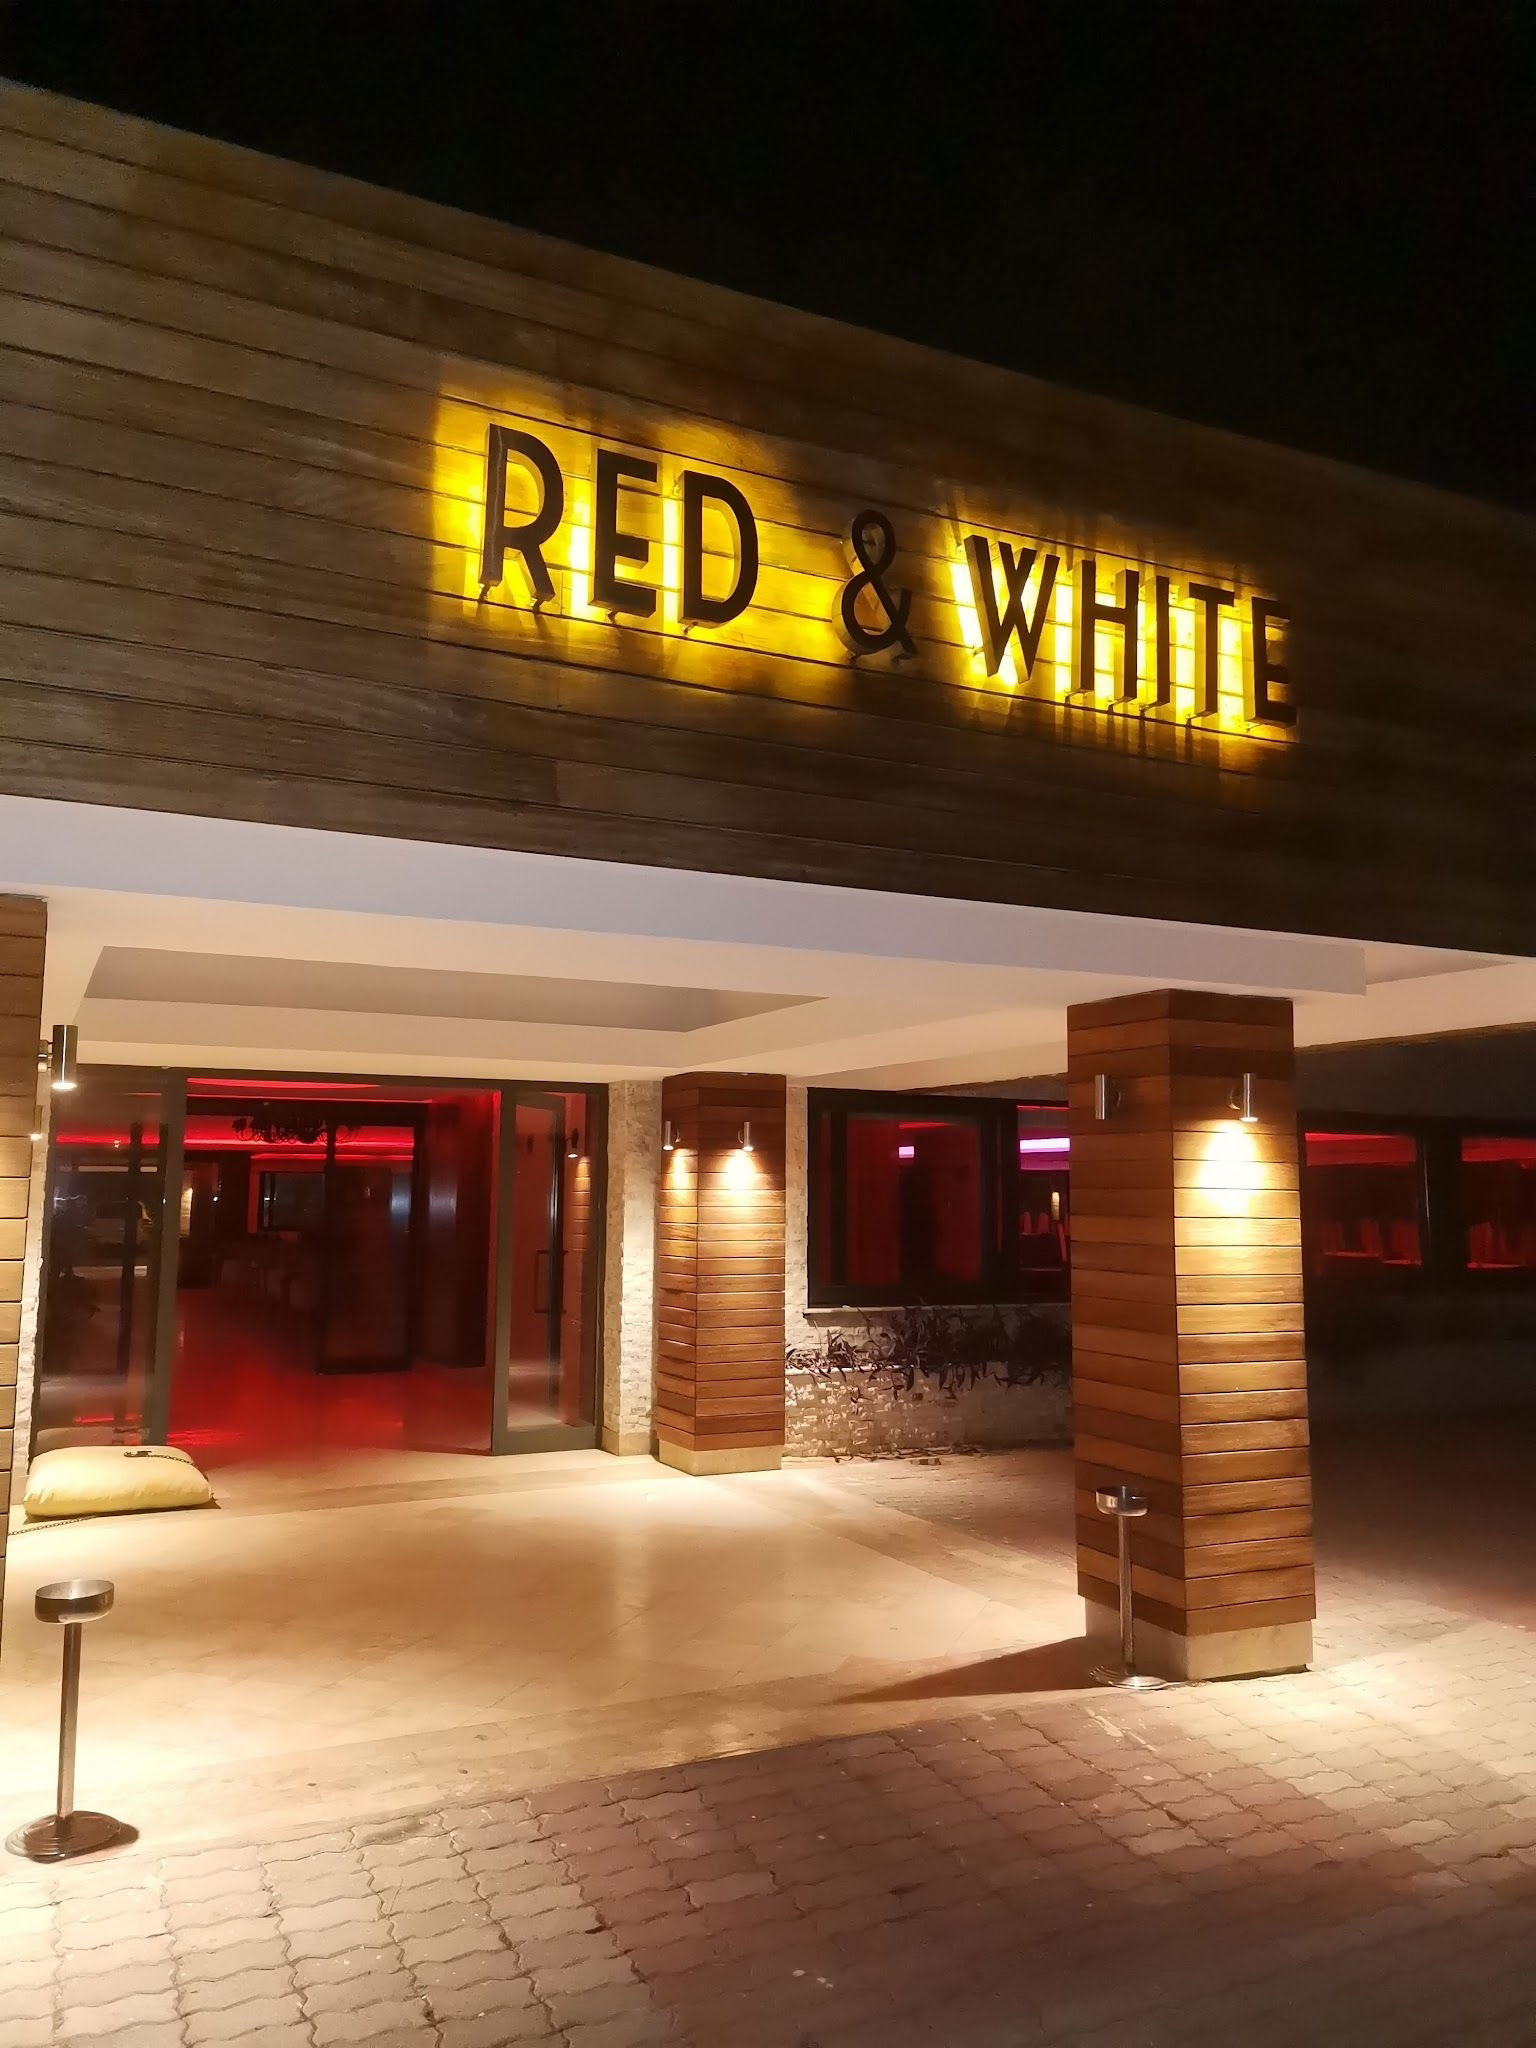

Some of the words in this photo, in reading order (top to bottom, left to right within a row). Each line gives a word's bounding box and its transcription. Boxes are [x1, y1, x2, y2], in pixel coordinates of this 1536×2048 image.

[480, 423, 759, 628] RED
[836, 509, 917, 656] &
[964, 535, 1297, 727] WHITE
